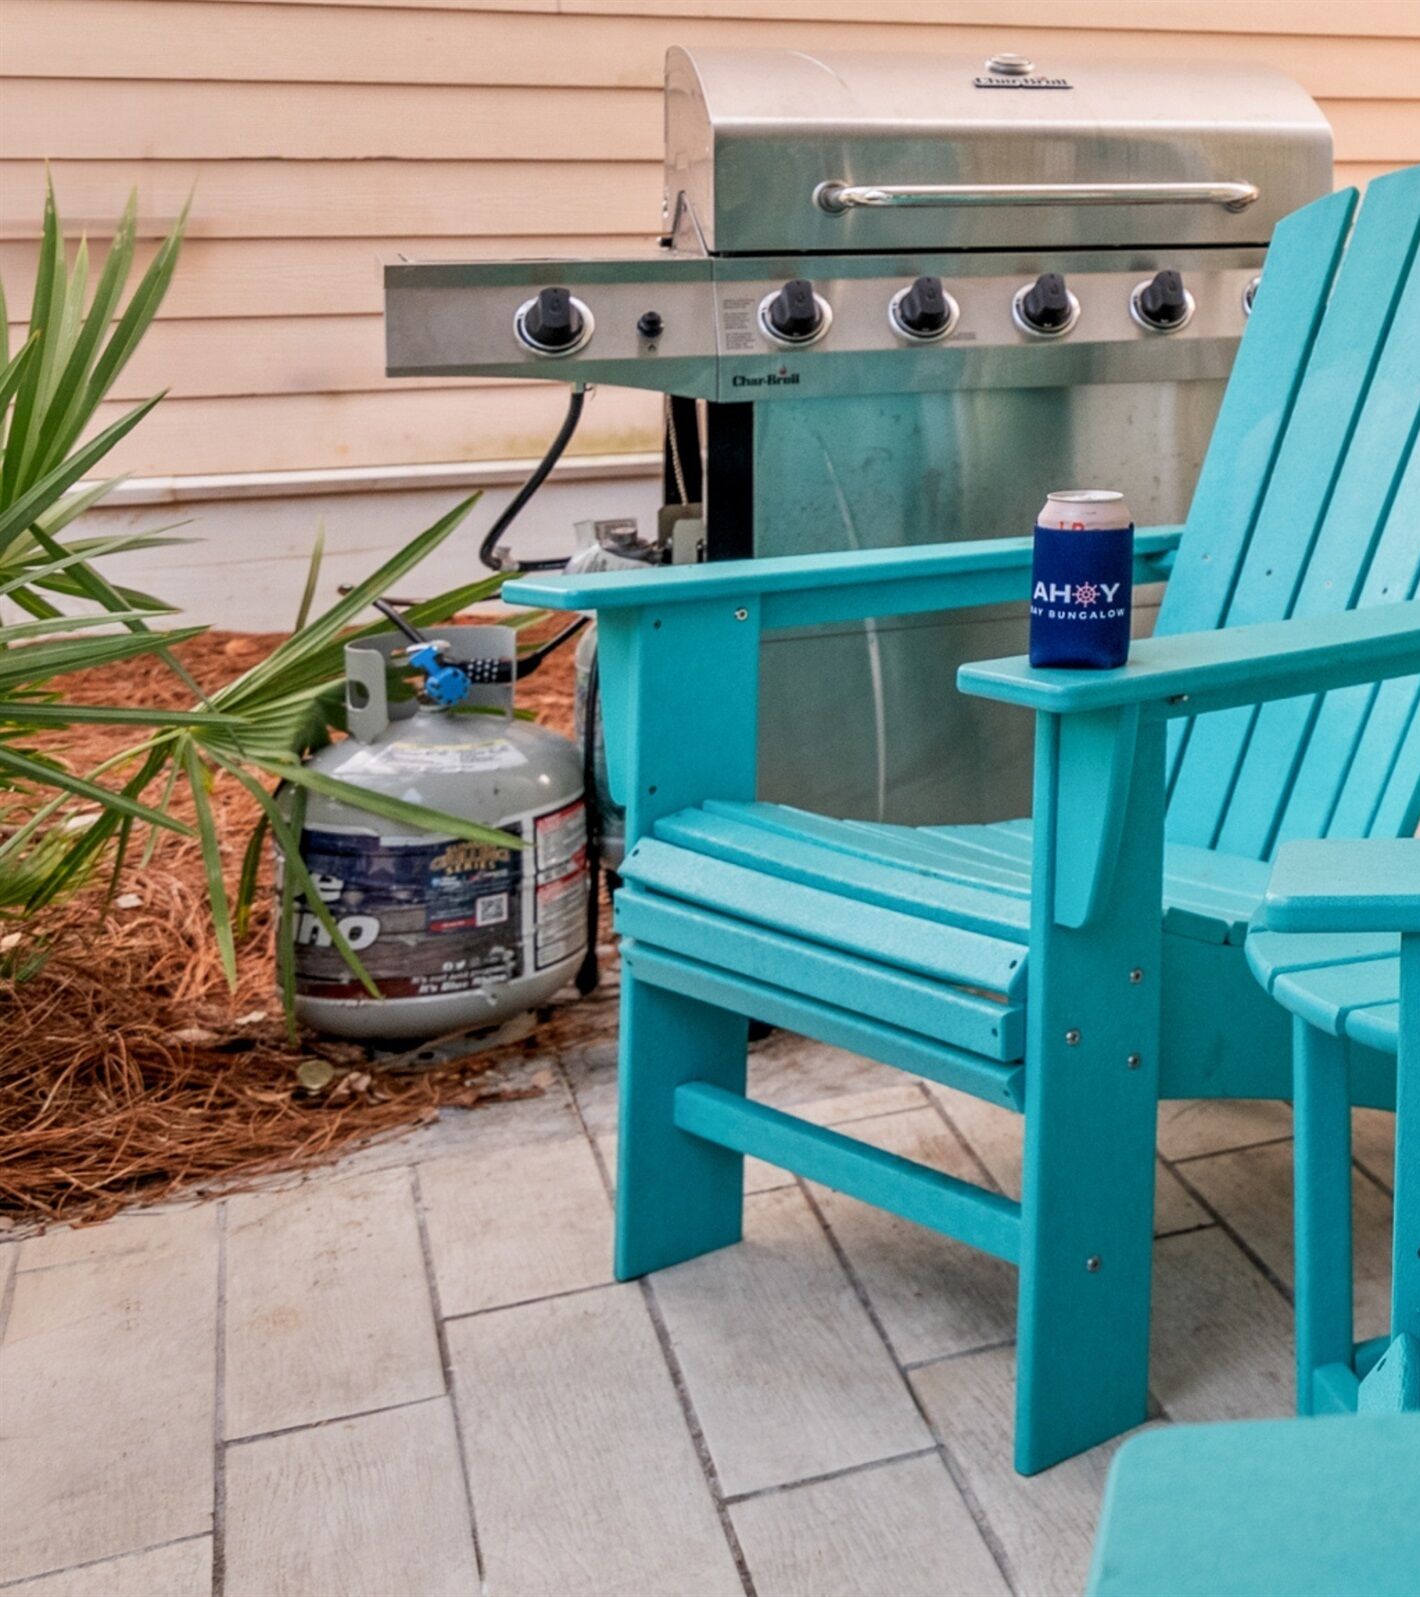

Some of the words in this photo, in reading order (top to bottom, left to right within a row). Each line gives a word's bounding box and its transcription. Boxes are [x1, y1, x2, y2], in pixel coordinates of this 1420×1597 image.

[732, 370, 800, 387] Char-Broil
[1033, 580, 1120, 608] AHOY
[1048, 608, 1126, 620] BUNGALOW
